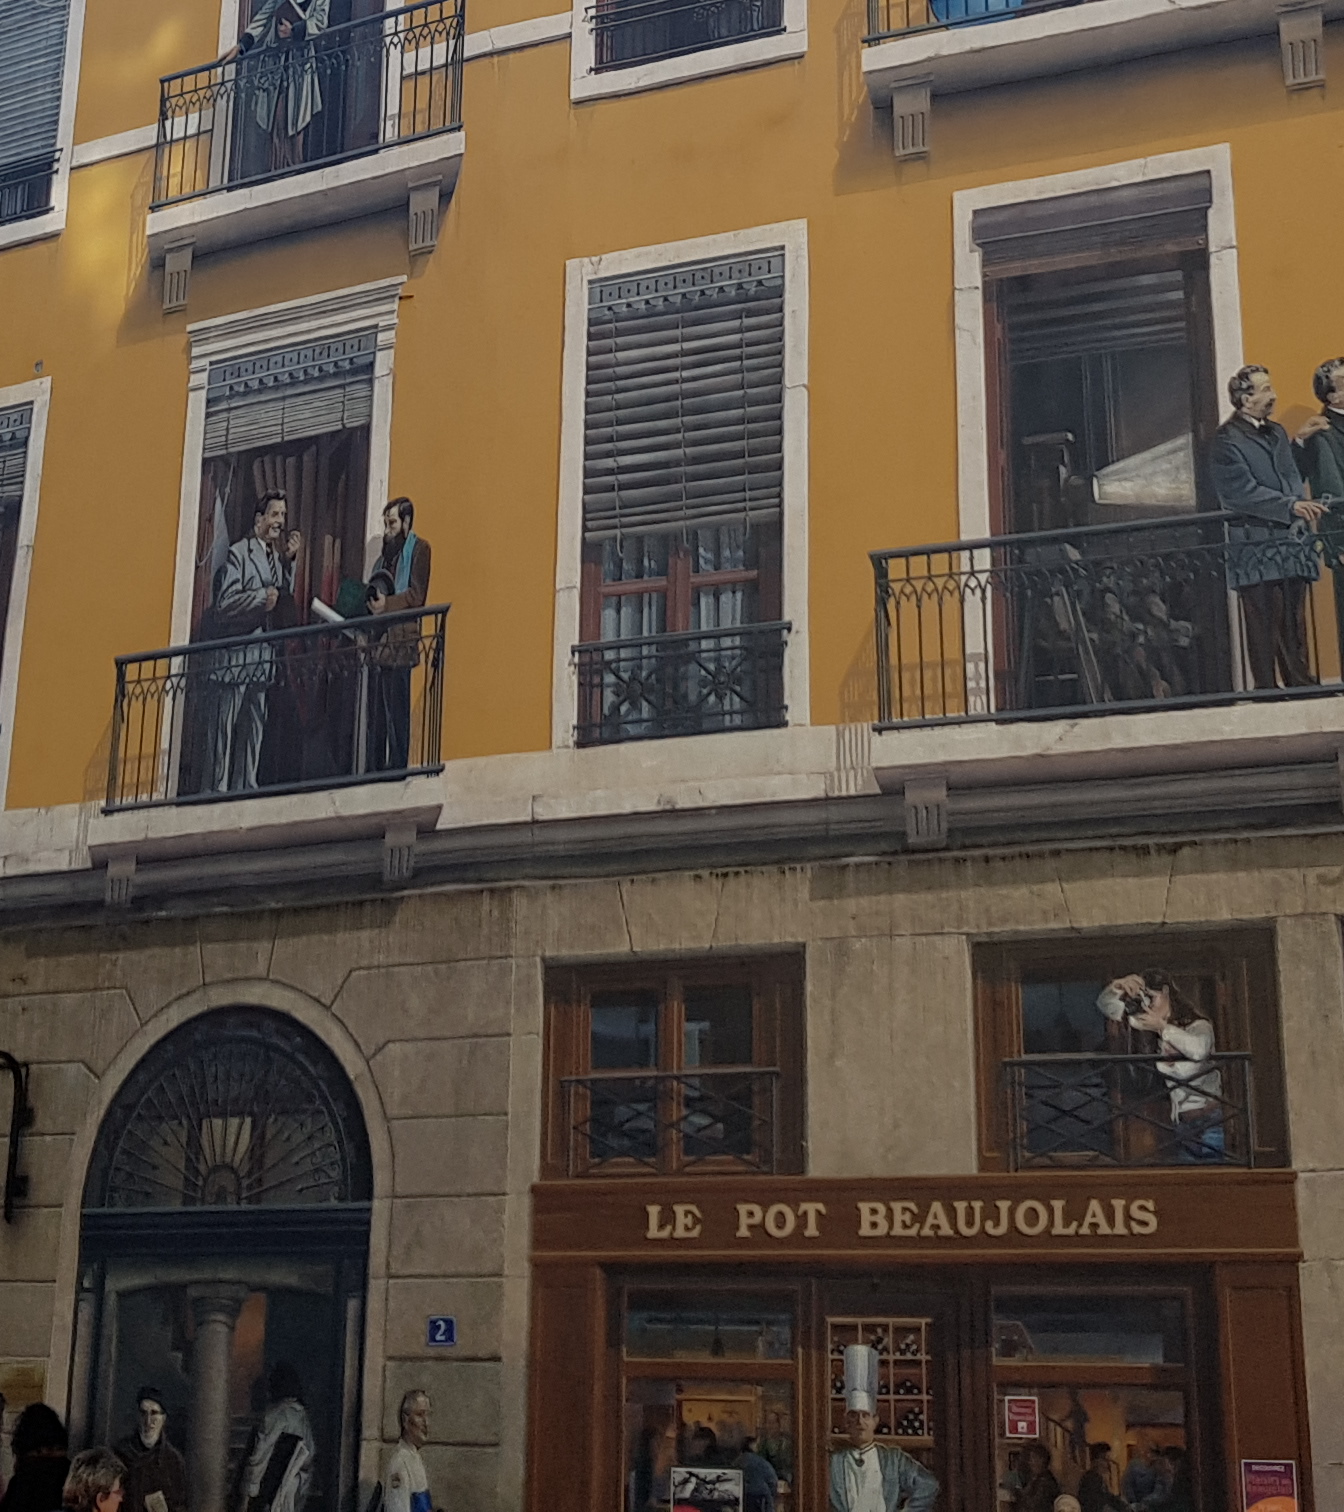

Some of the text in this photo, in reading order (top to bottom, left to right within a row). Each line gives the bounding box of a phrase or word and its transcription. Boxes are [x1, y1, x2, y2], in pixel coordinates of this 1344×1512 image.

[644, 1198, 1158, 1239] LE POT BEAUJOLAIS
[435, 1319, 446, 1341] 2
